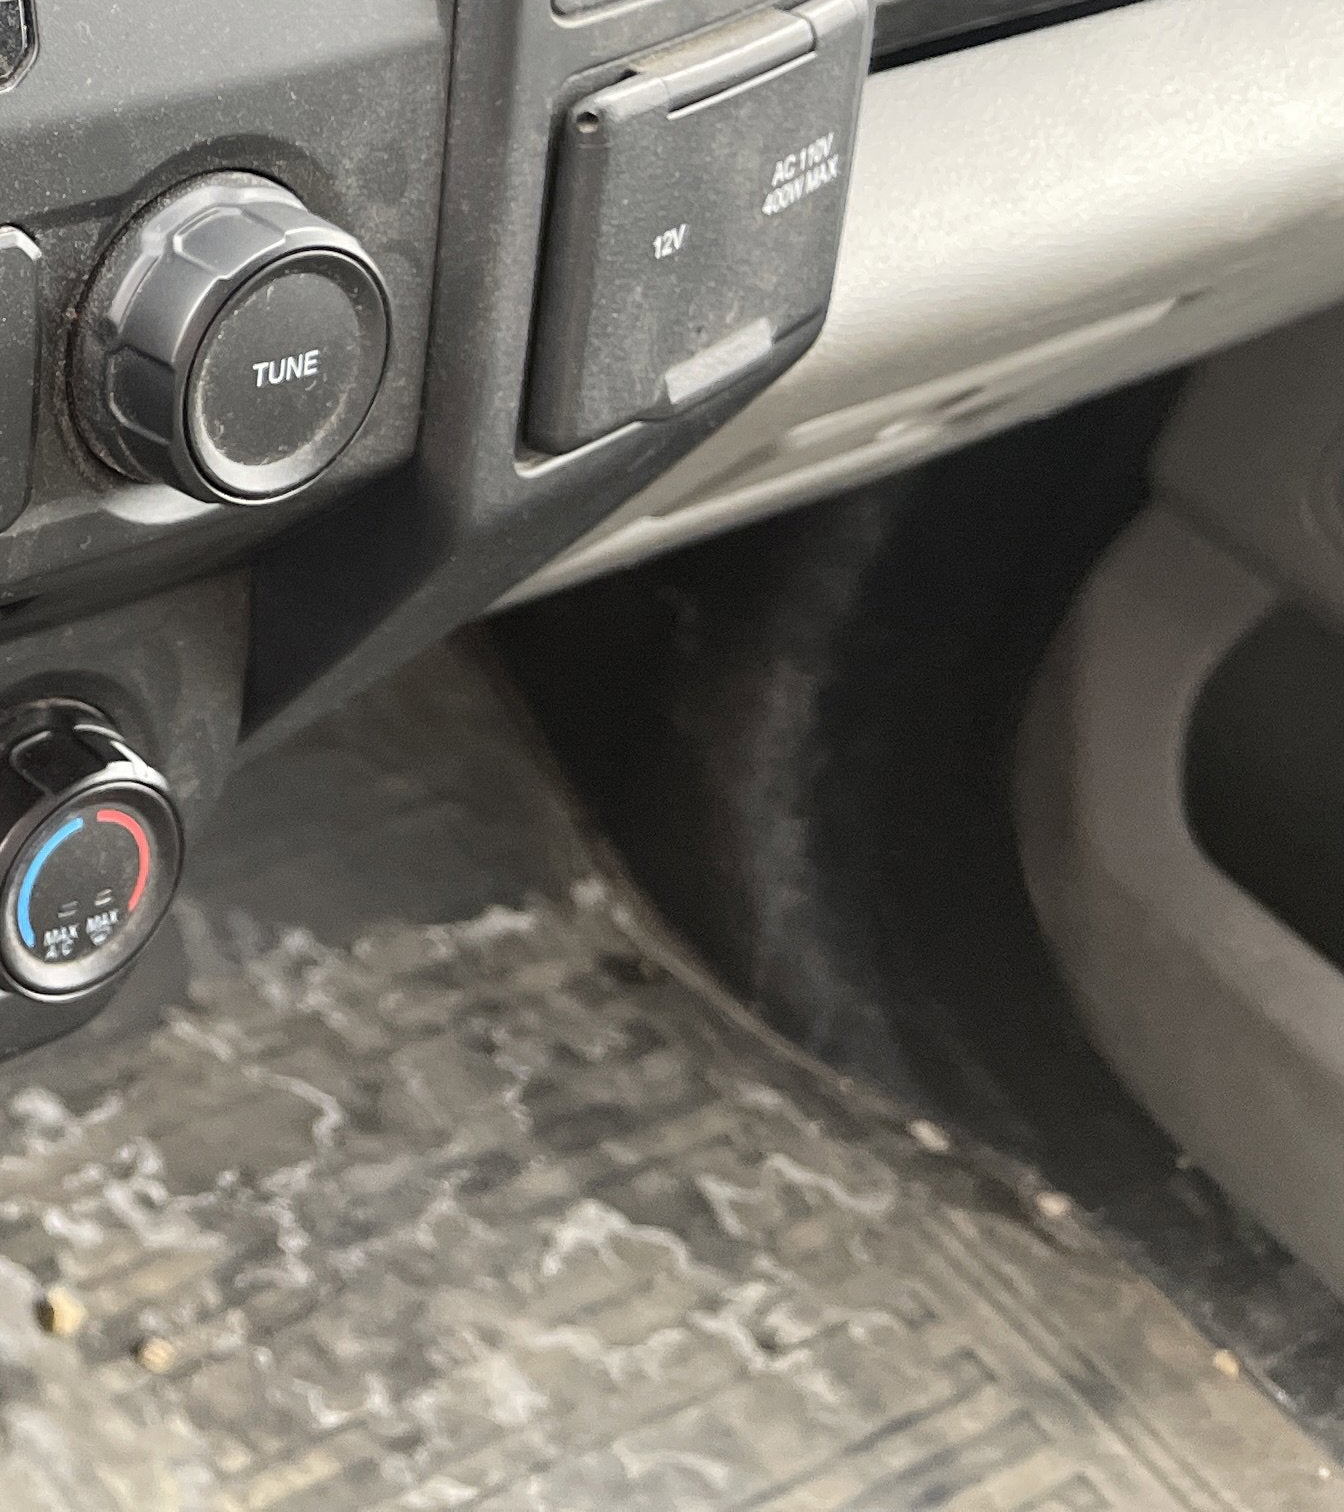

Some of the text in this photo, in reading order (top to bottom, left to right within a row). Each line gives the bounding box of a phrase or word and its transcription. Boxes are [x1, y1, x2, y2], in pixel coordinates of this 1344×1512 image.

[653, 224, 687, 259] 12V
[253, 350, 319, 388] TUNE
[44, 924, 79, 946] MAX
